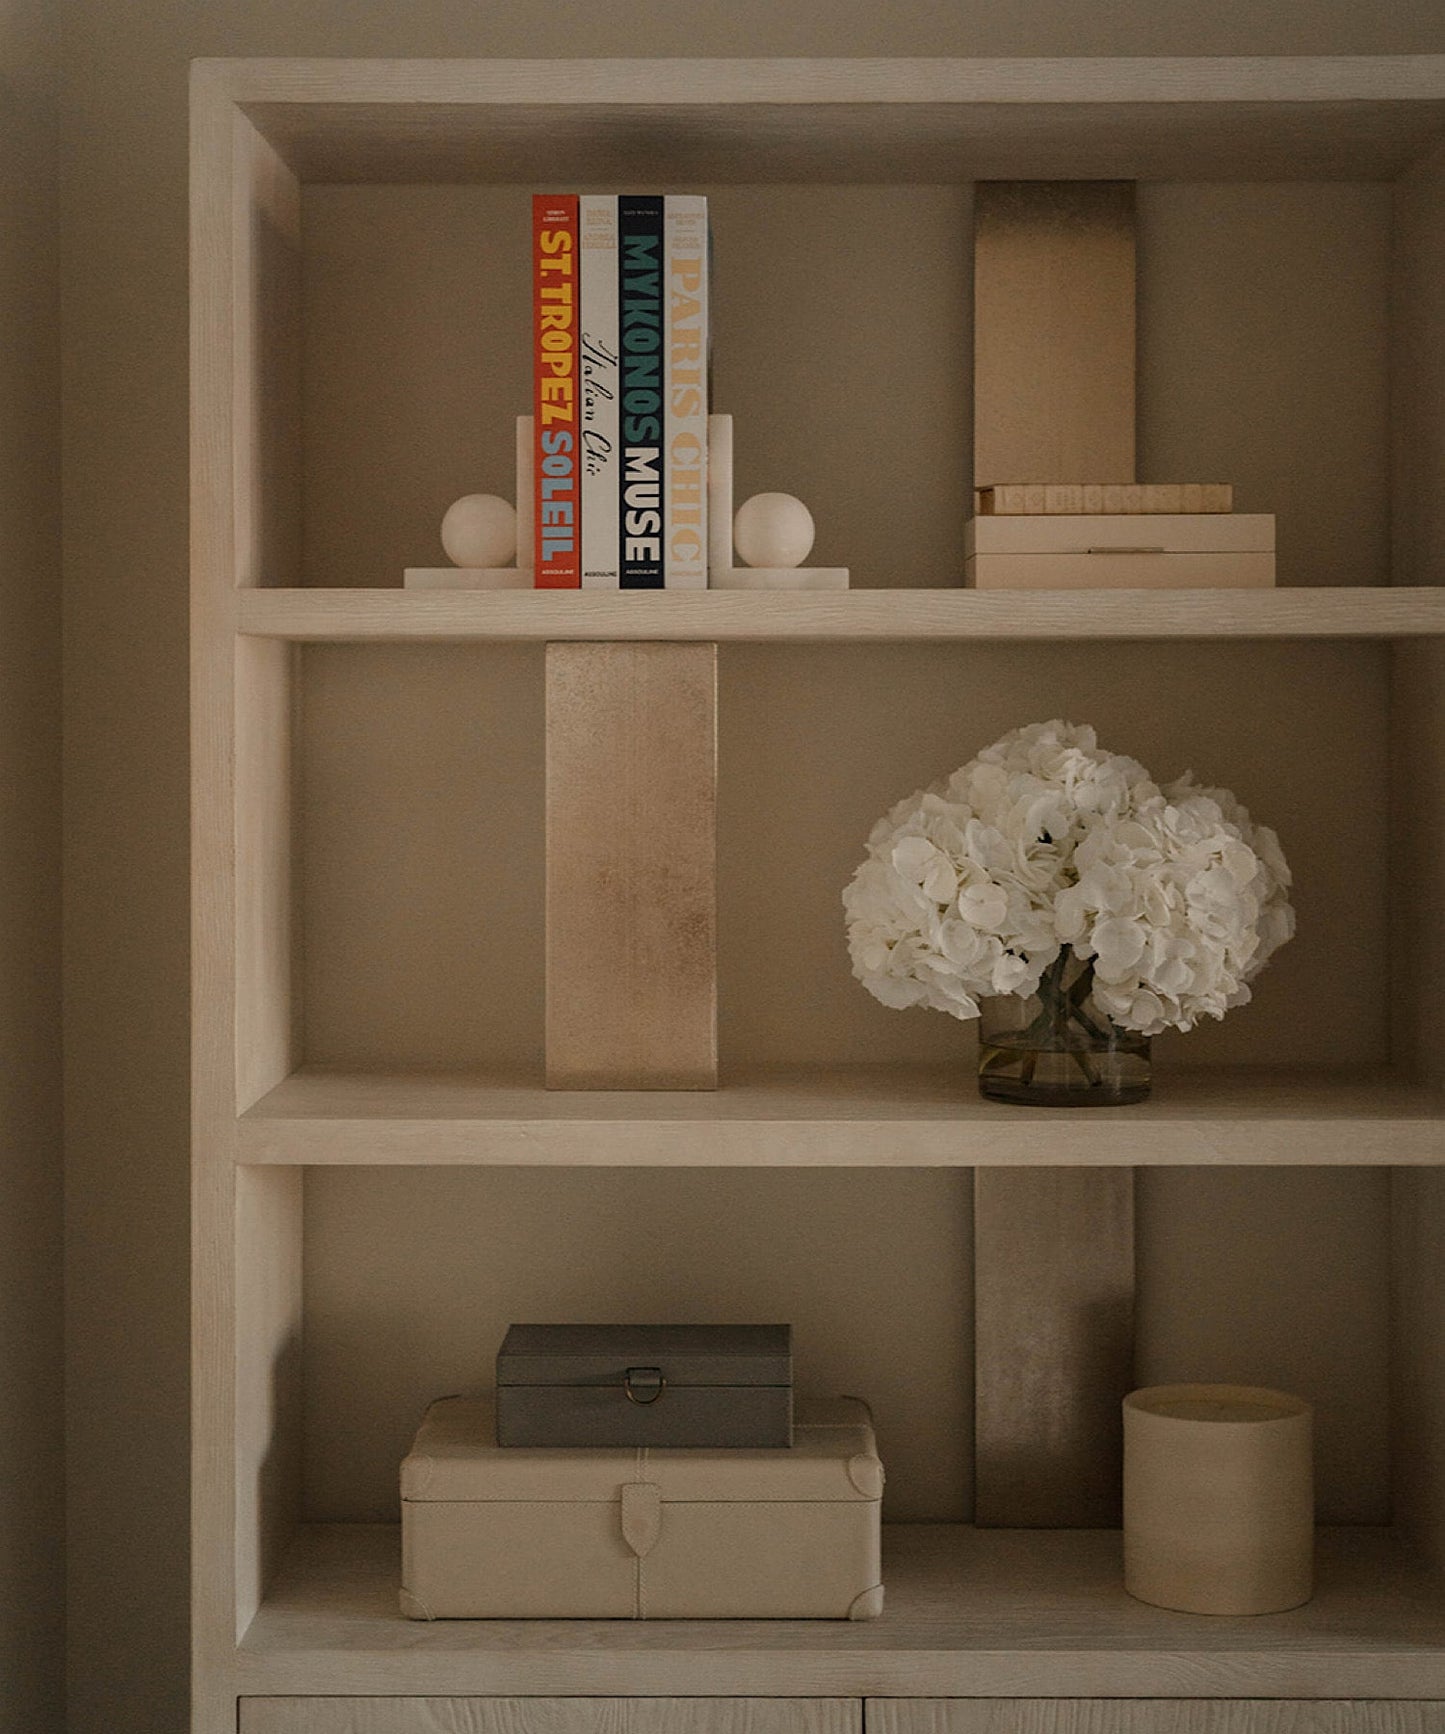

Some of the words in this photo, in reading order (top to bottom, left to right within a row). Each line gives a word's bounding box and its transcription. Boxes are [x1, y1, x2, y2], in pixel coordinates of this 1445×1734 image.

[540, 230, 573, 277] ST.
[540, 282, 573, 425] TROPEZ
[581, 332, 618, 421] Italian
[623, 235, 661, 443] MYKONOS
[670, 256, 702, 418] PARIS
[541, 430, 574, 561] SOLEIL
[582, 430, 612, 477] Chic
[624, 447, 661, 561] MUSE
[670, 432, 702, 562] CHIC
